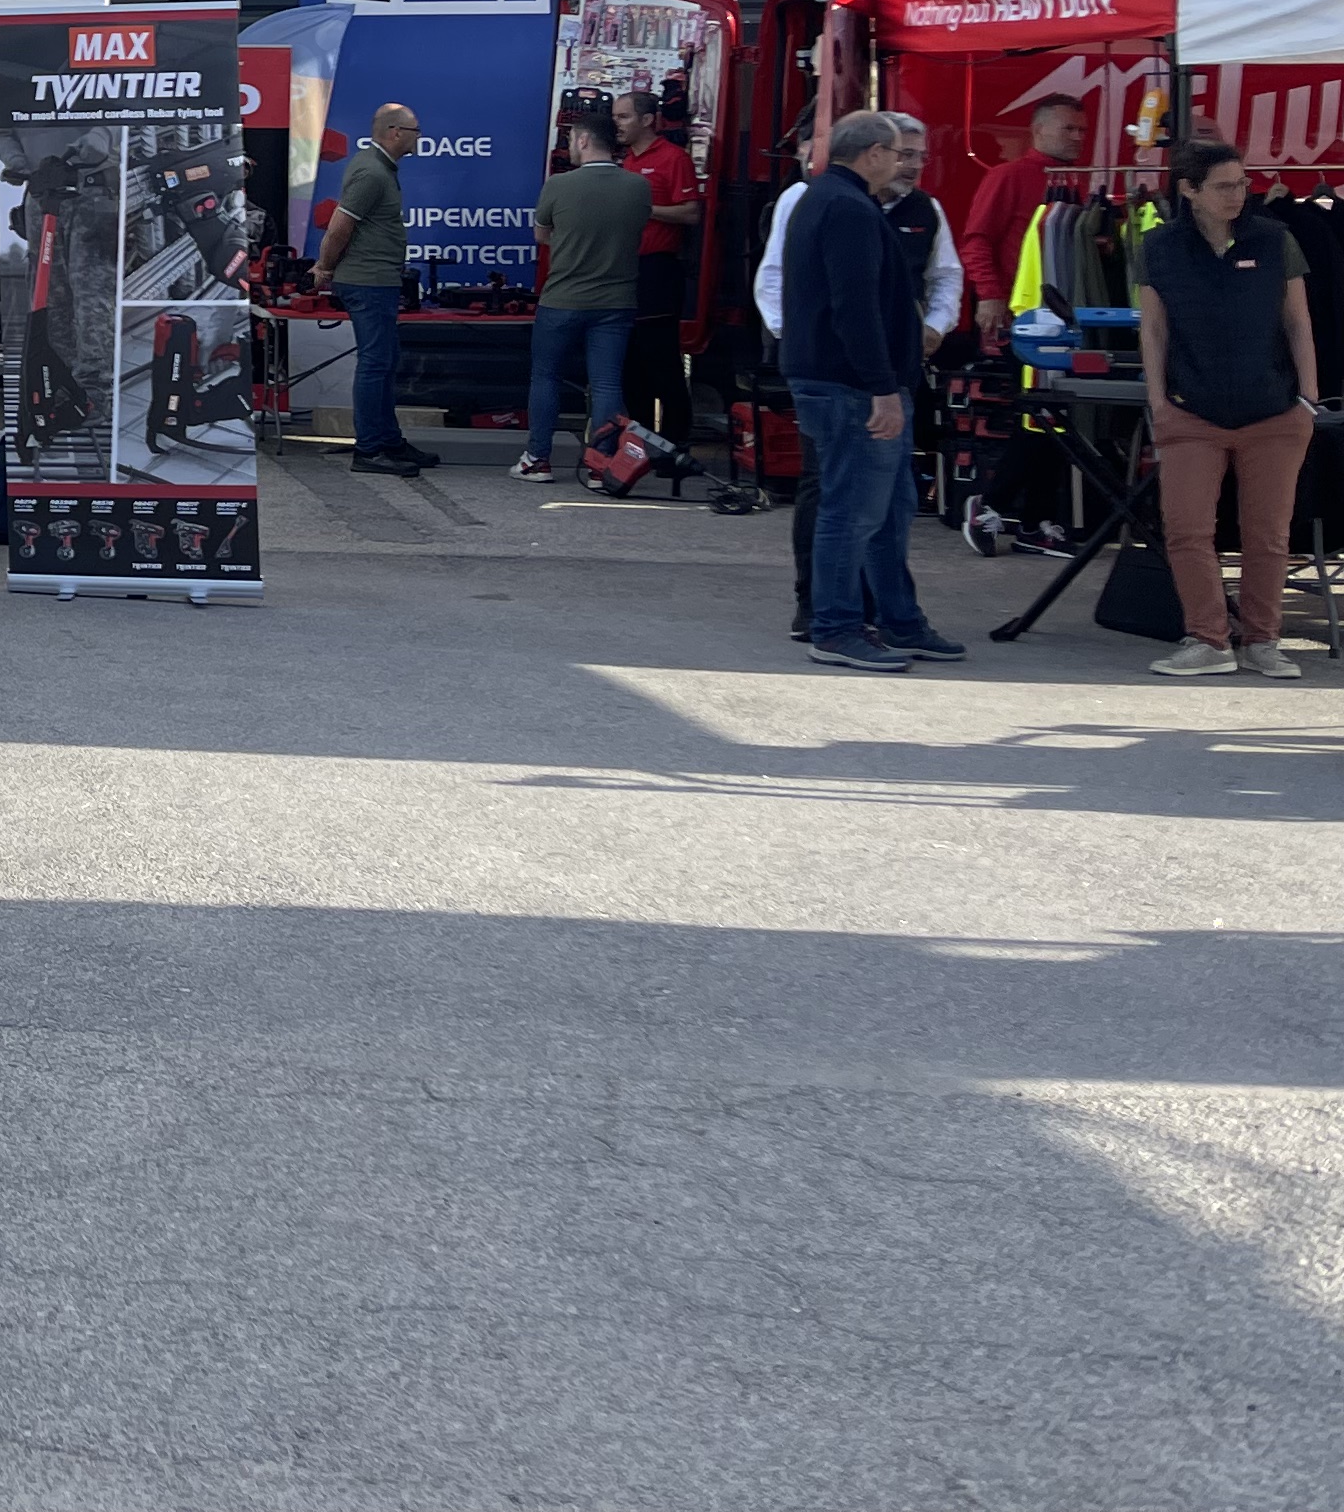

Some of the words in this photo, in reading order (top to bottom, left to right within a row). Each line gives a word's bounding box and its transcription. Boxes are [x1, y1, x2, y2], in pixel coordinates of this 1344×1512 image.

[903, 0, 962, 31] Nothing
[74, 31, 150, 62] MAX
[31, 71, 202, 110] TWINTIER
[11, 111, 30, 121] The
[177, 107, 203, 119] tying
[204, 107, 225, 118] tool
[357, 137, 493, 157] SDAGE
[400, 207, 537, 228] UIPEMENT
[404, 244, 539, 265] PROTECTI
